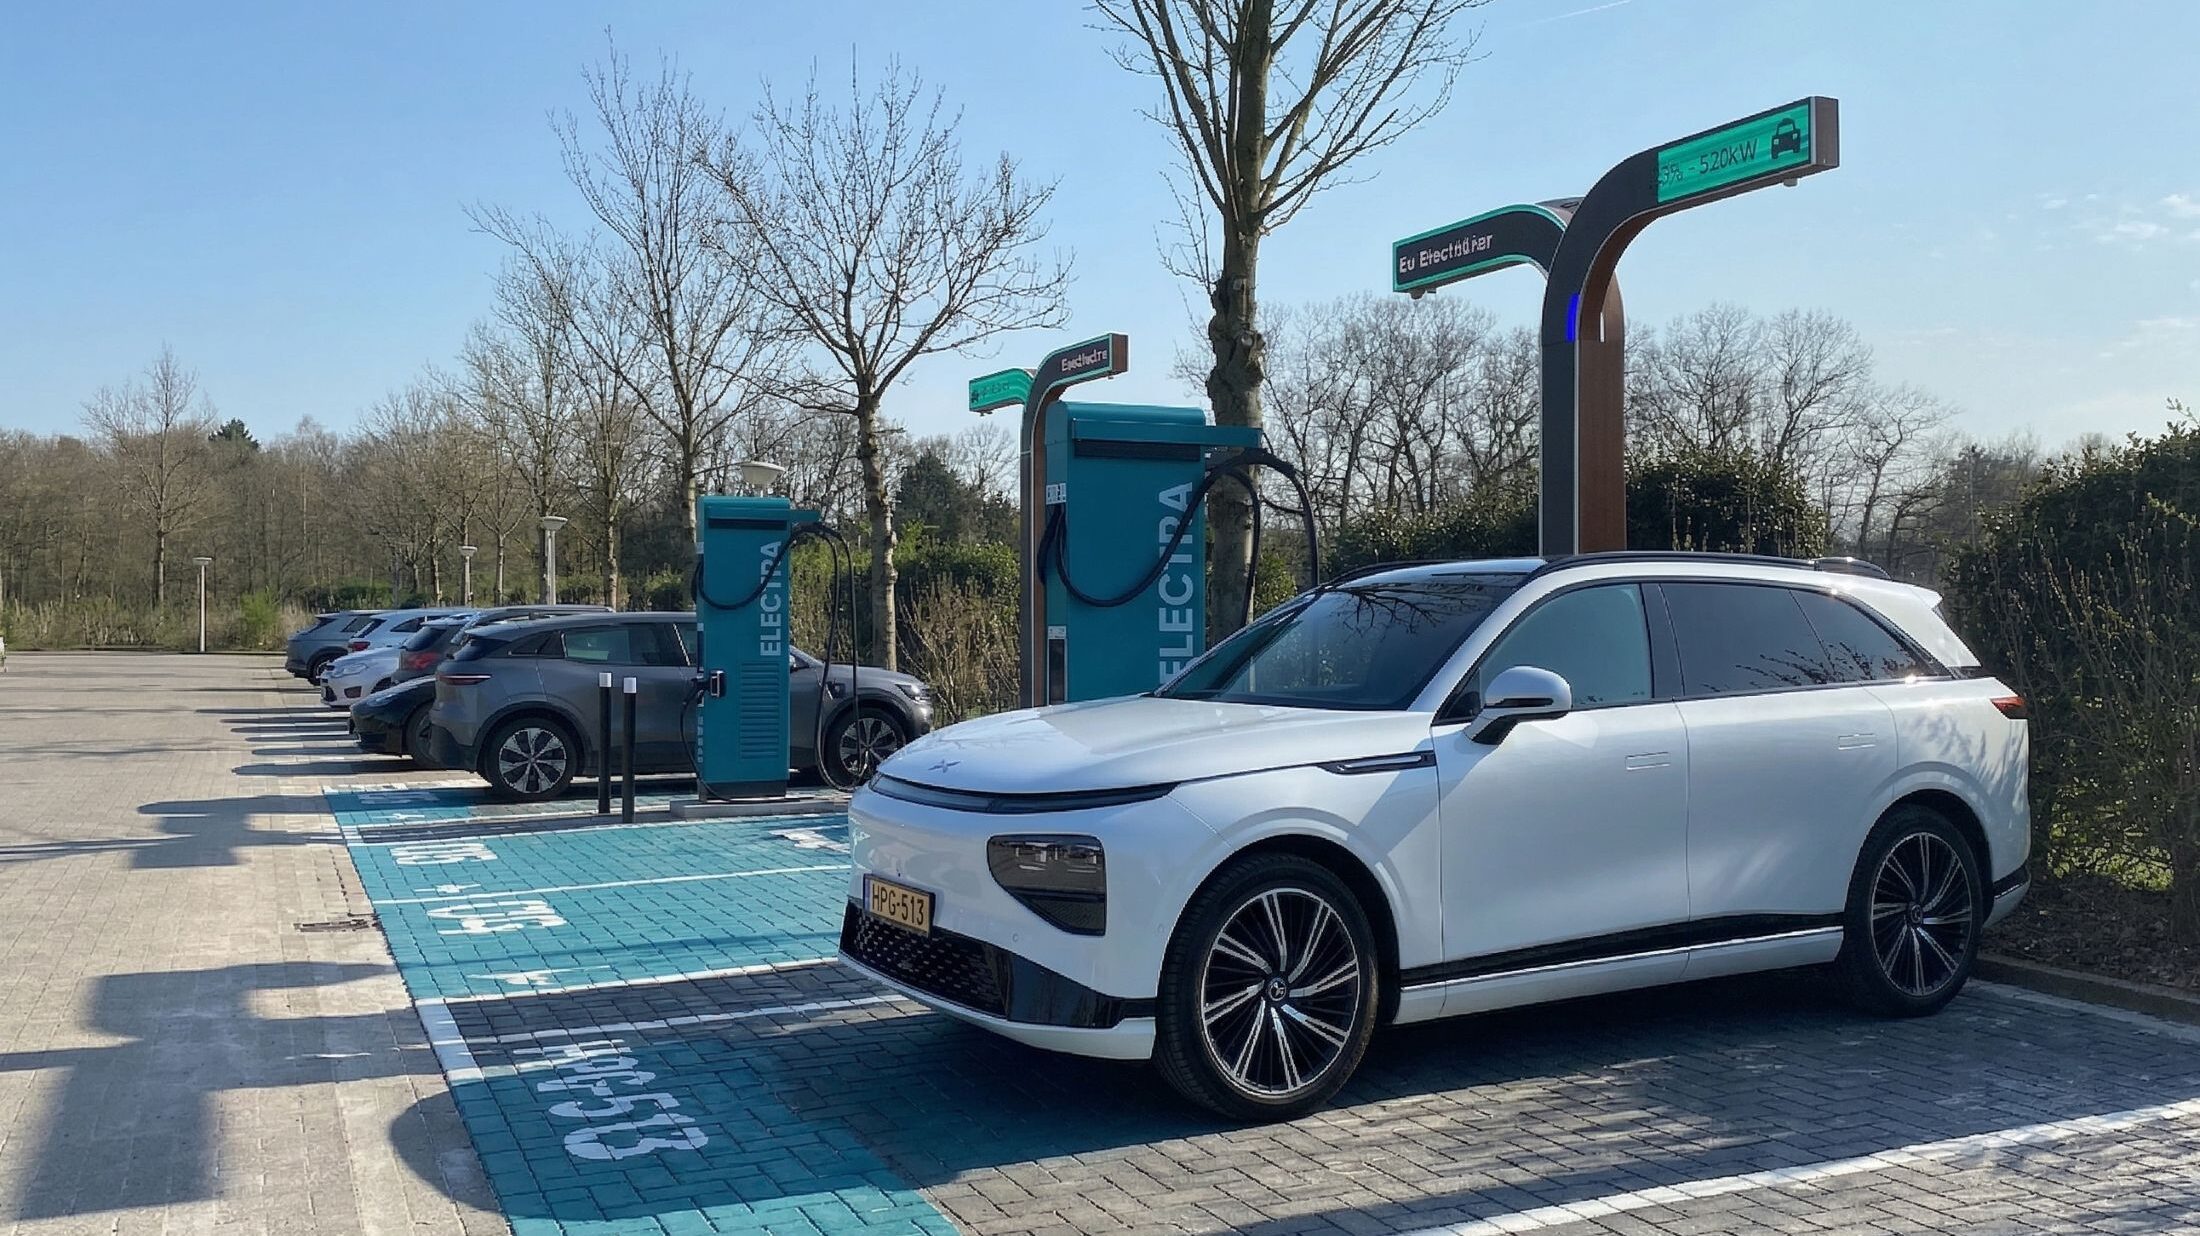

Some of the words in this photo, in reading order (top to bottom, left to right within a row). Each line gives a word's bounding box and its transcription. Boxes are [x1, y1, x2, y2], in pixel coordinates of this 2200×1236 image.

[1699, 138, 1759, 174] 520kW
[760, 541, 782, 656] ELECTRA
[1158, 481, 1193, 684] ELECTRA
[872, 883, 924, 925] HPG-513
